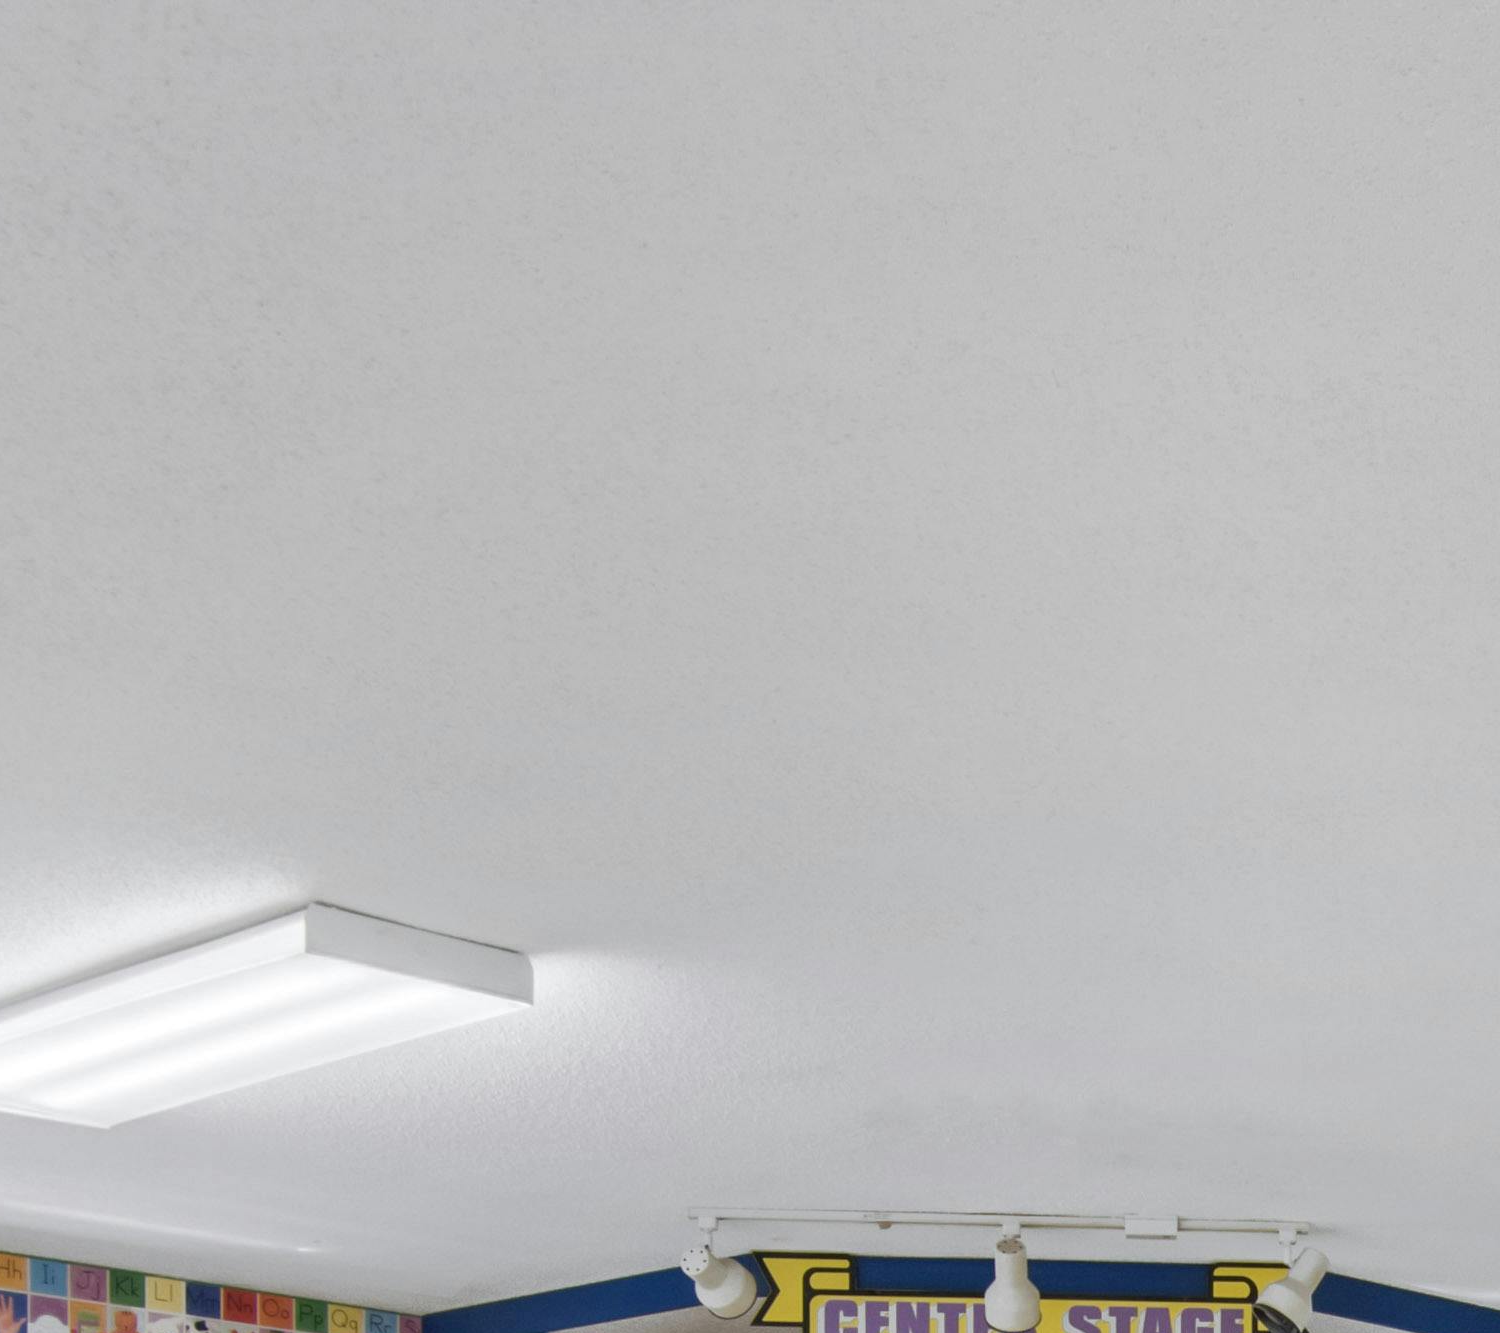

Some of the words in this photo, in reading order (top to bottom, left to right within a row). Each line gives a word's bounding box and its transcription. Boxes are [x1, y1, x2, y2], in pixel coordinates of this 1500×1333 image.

[41, 1263, 56, 1286] Ii
[76, 1271, 101, 1298] Jj
[115, 1276, 140, 1297] Kk
[152, 1280, 177, 1302] Ll
[226, 1292, 254, 1315] Nn
[264, 1298, 290, 1320] Oo
[299, 1303, 325, 1329] Pp
[368, 1312, 392, 1333] Rr
